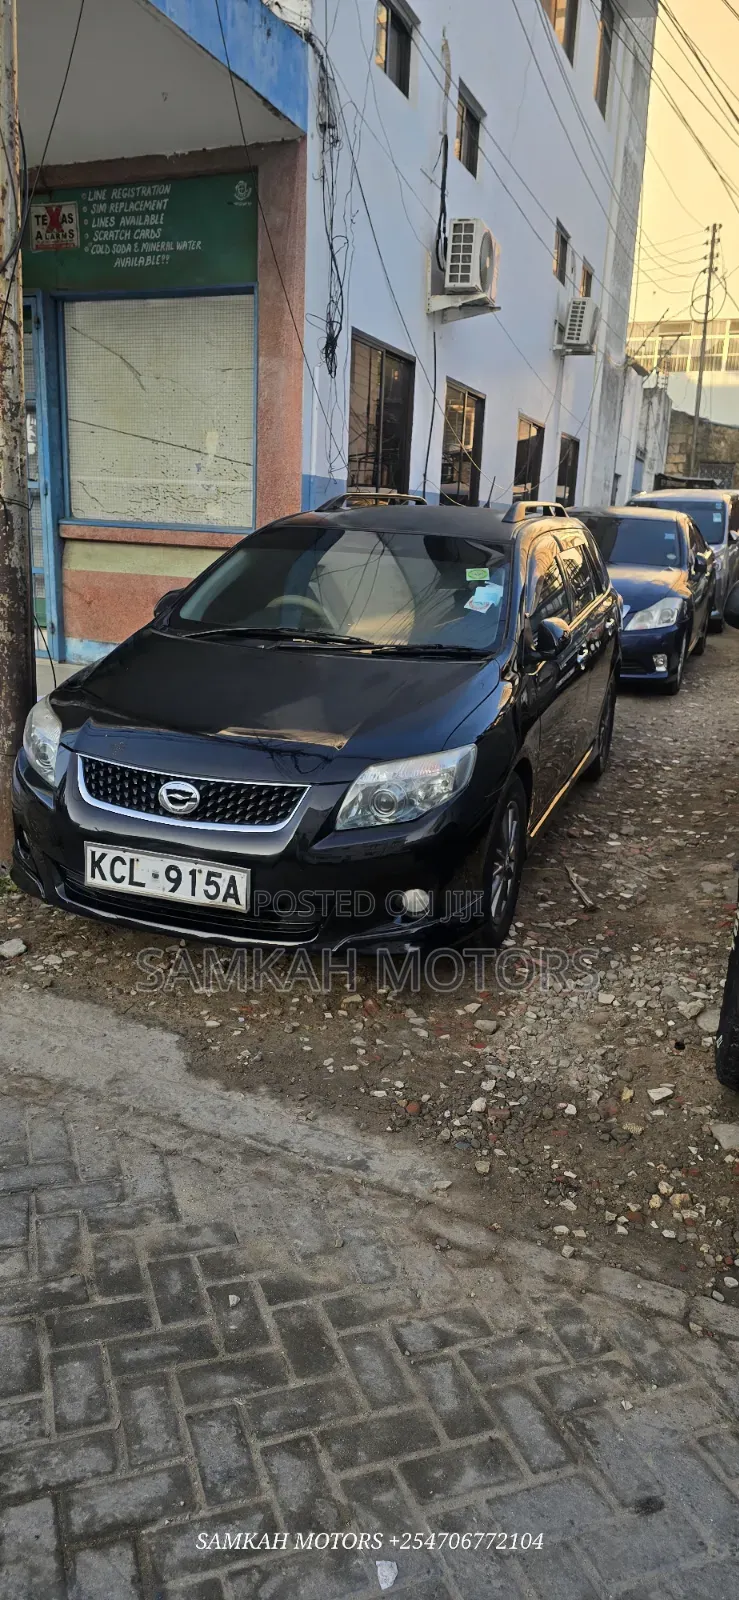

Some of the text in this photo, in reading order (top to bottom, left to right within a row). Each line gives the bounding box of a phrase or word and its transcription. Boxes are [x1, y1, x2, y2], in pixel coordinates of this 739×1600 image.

[88, 184, 172, 201] LINE REGISTRATION
[91, 198, 169, 214] SIM REPLACEMENT
[34, 204, 74, 233] TEXAS
[92, 213, 165, 228] LINES AVAILABLE
[35, 229, 75, 241] ALARMS
[93, 228, 162, 242] SCRATCH CARDS
[91, 243, 111, 255] COLD
[112, 243, 132, 254] SODA
[141, 241, 174, 253] MINERAL
[176, 240, 202, 251] WATER
[90, 850, 242, 906] KCL 915A
